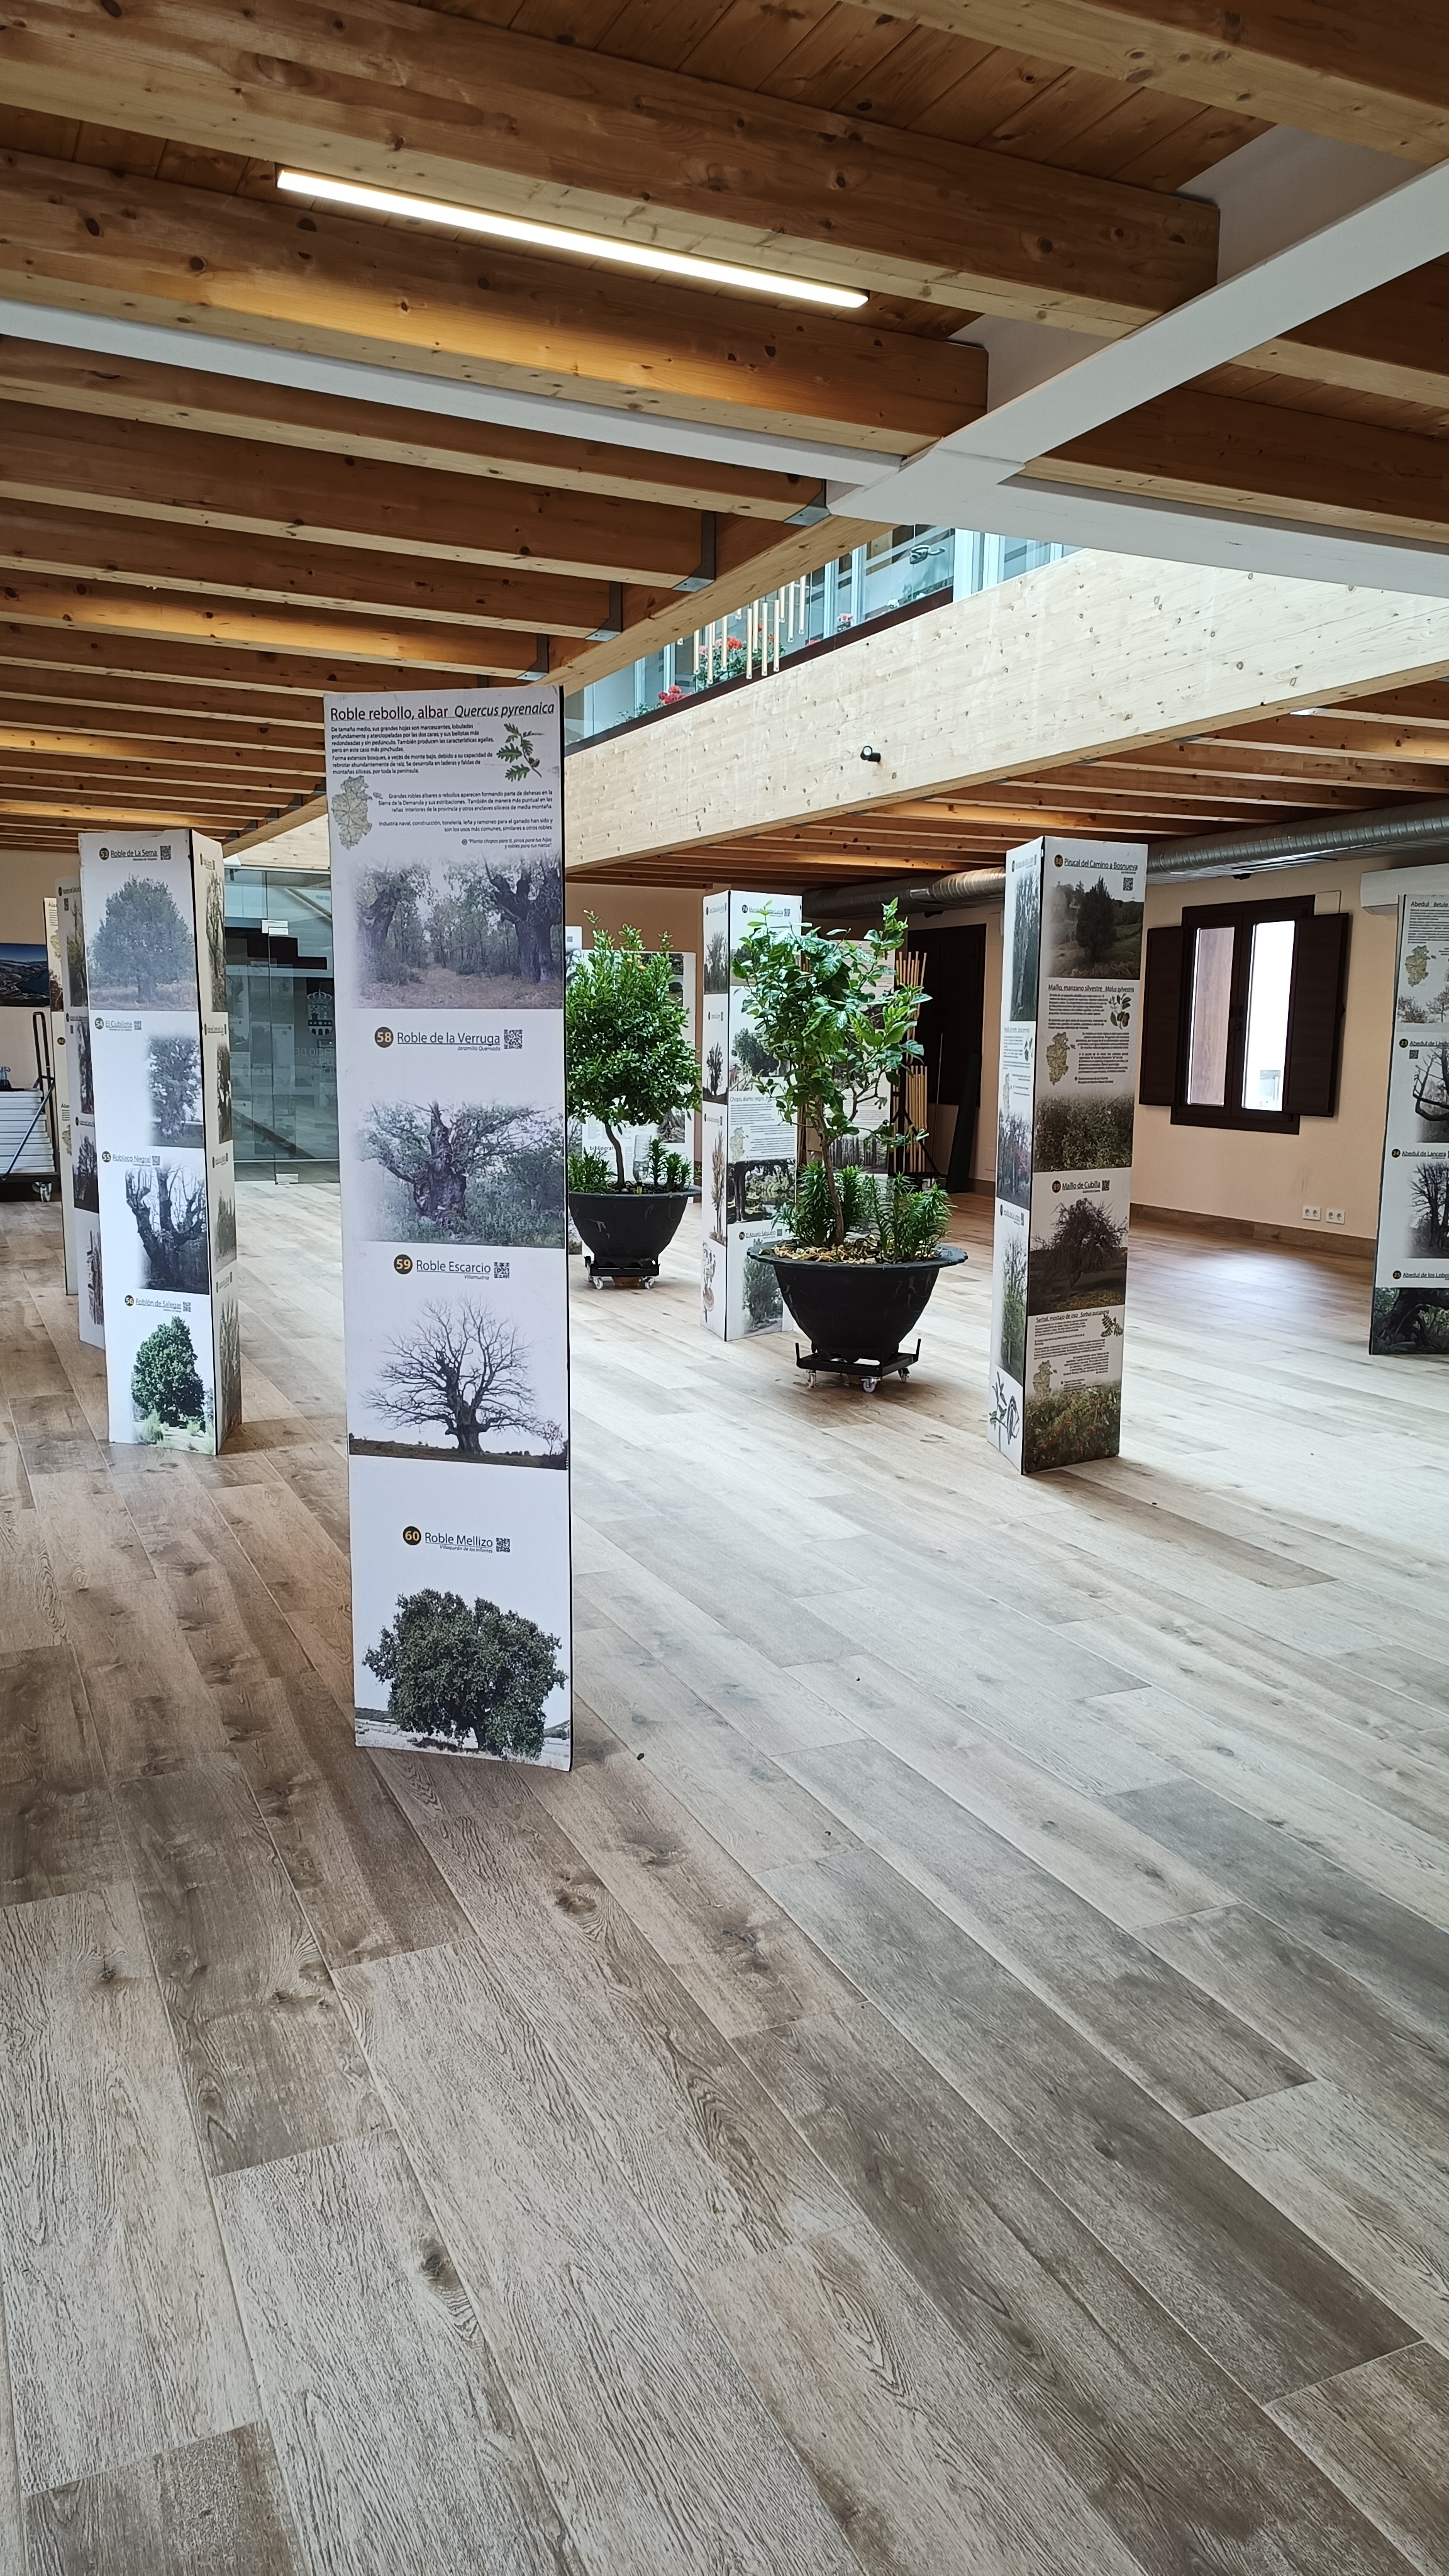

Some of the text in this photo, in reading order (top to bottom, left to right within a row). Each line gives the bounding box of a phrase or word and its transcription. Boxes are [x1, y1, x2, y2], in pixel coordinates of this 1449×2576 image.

[331, 702, 554, 721] Roble rebollo, albar Quercus pyrenaica
[1090, 860, 1108, 869] Camino
[377, 1032, 500, 1046] 58 Roble de la Verruga
[396, 1259, 491, 1273] 59 Roble Escarcio
[405, 1531, 493, 1548] 60 Roble Mellizo
